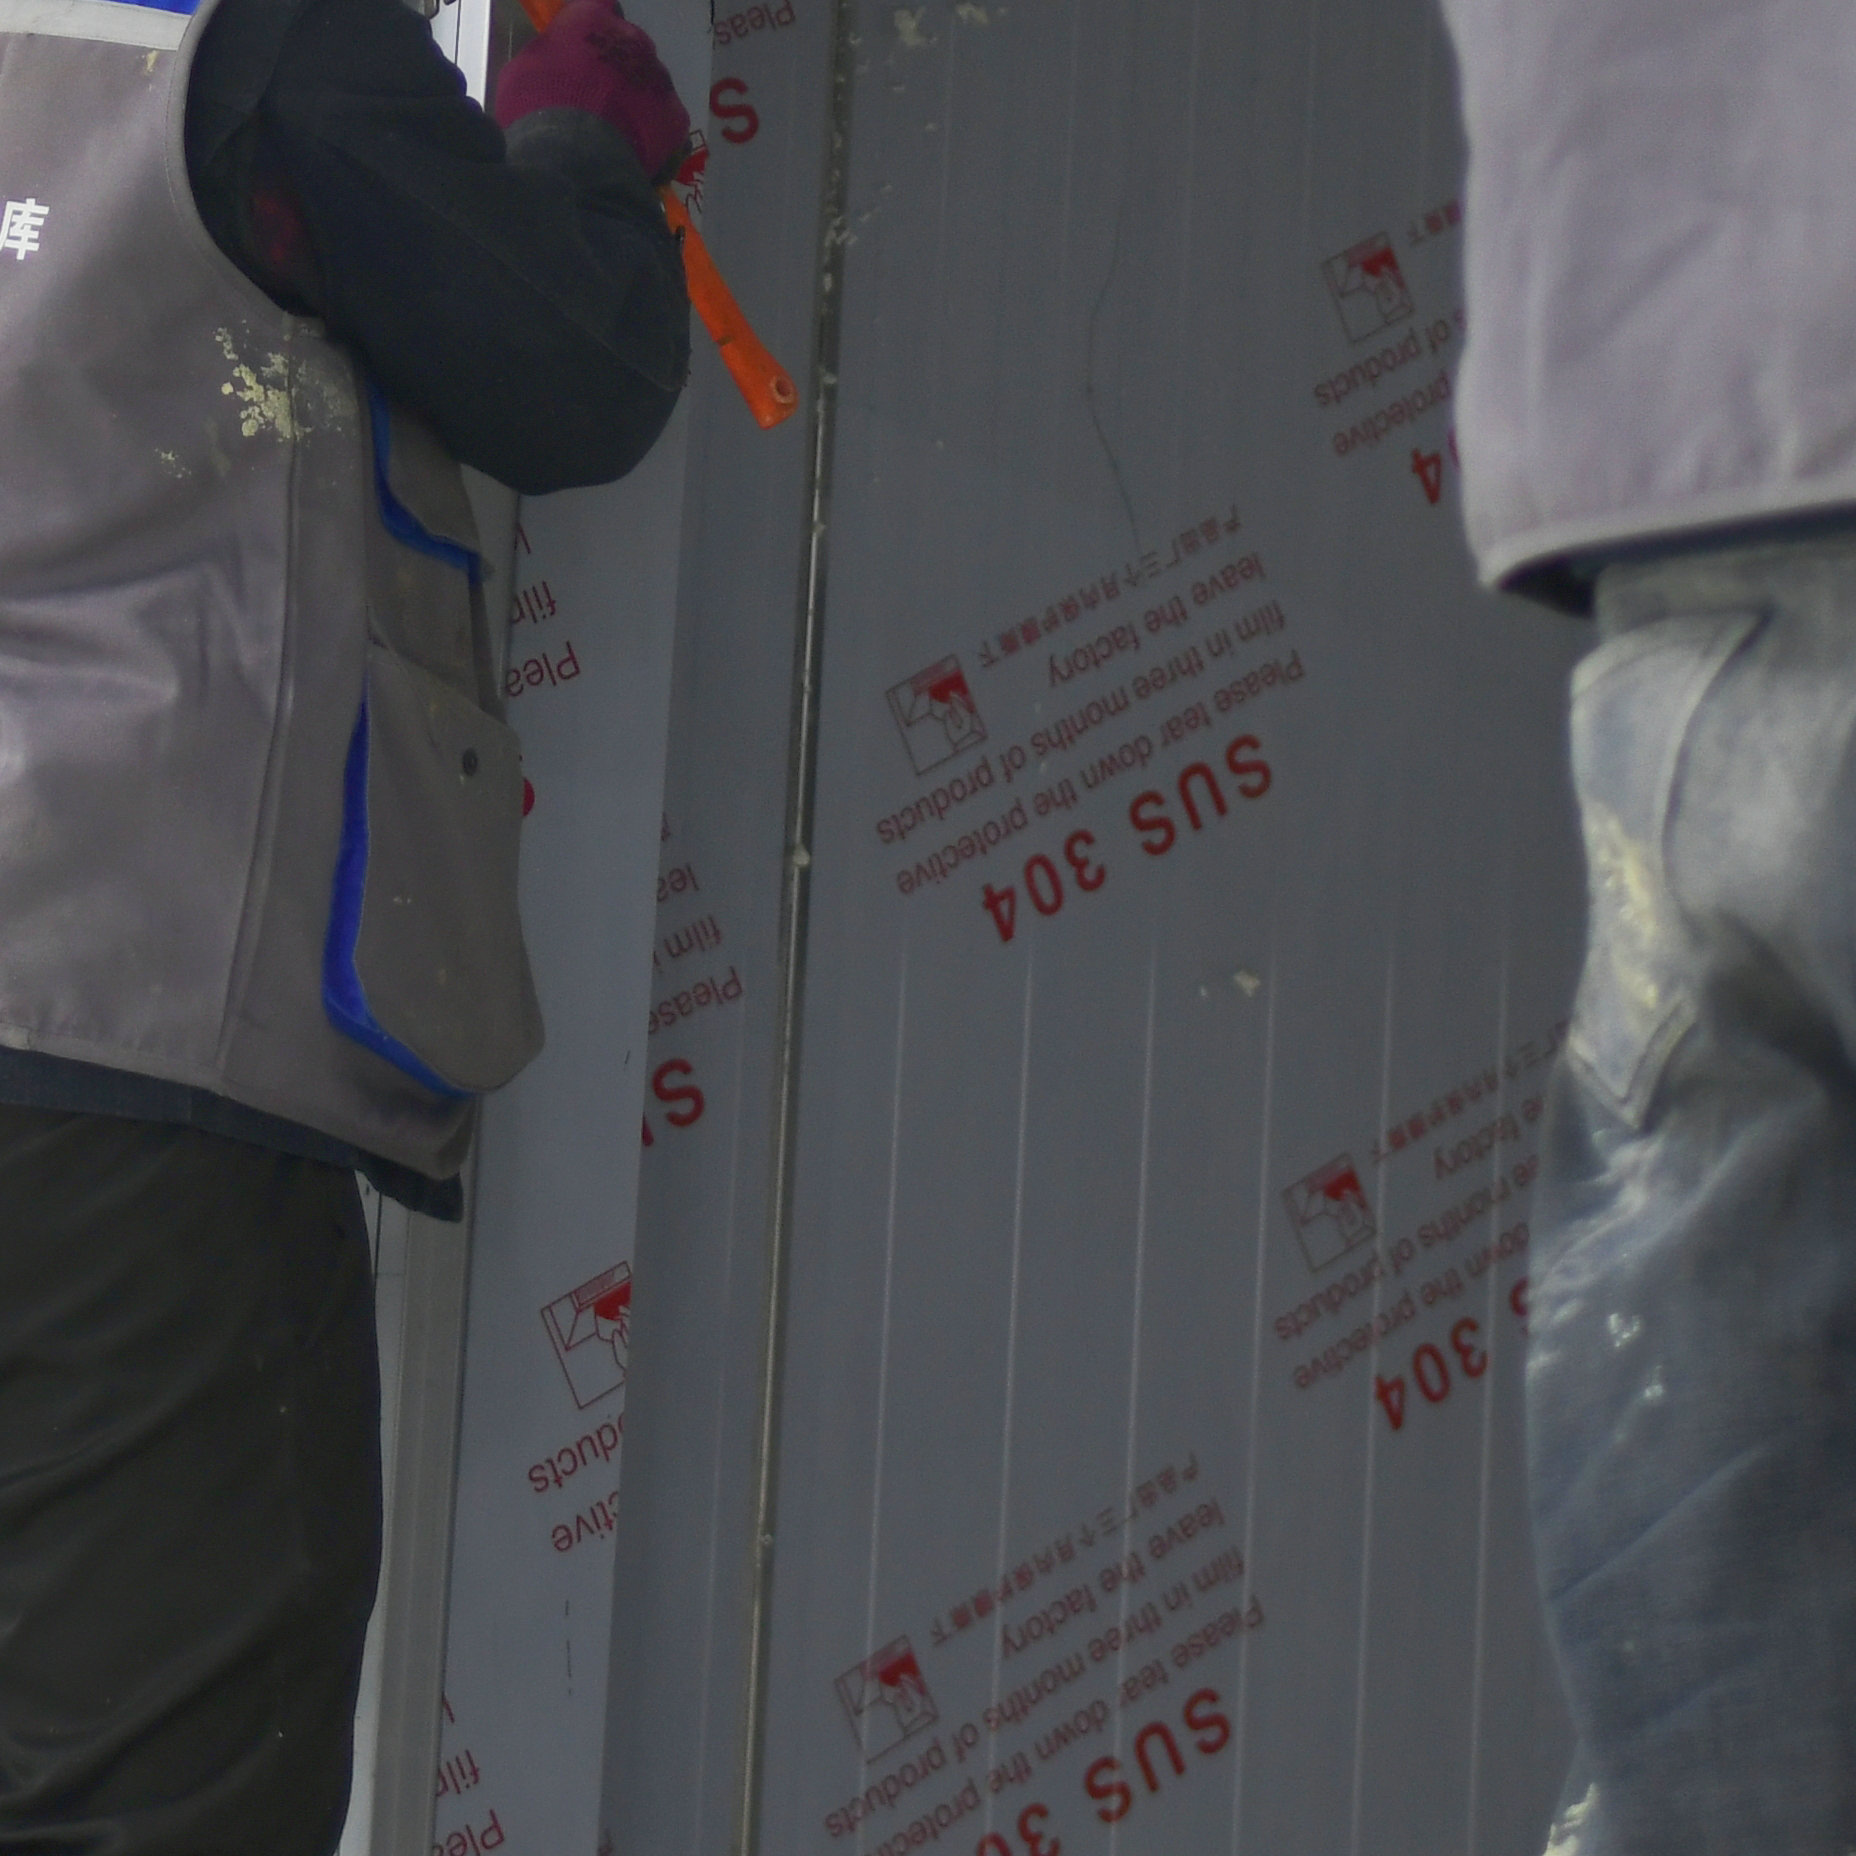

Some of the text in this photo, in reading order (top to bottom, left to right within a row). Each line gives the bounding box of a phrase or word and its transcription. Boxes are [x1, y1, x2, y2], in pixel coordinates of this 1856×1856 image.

[1048, 556, 1265, 687] leave the factory
[876, 605, 1285, 844] film in three months of products
[897, 650, 1306, 895] Please tear down the protective
[982, 735, 1271, 943] SUS 304
[1002, 1502, 1224, 1659] leave the factory
[1171, 1596, 1265, 1669] Please
[824, 1550, 1243, 1839] film in three months of products
[1035, 1700, 1108, 1761] down
[1121, 1660, 1167, 1707] tear
[991, 1752, 1032, 1794] the
[1084, 1688, 1230, 1823] SUS
